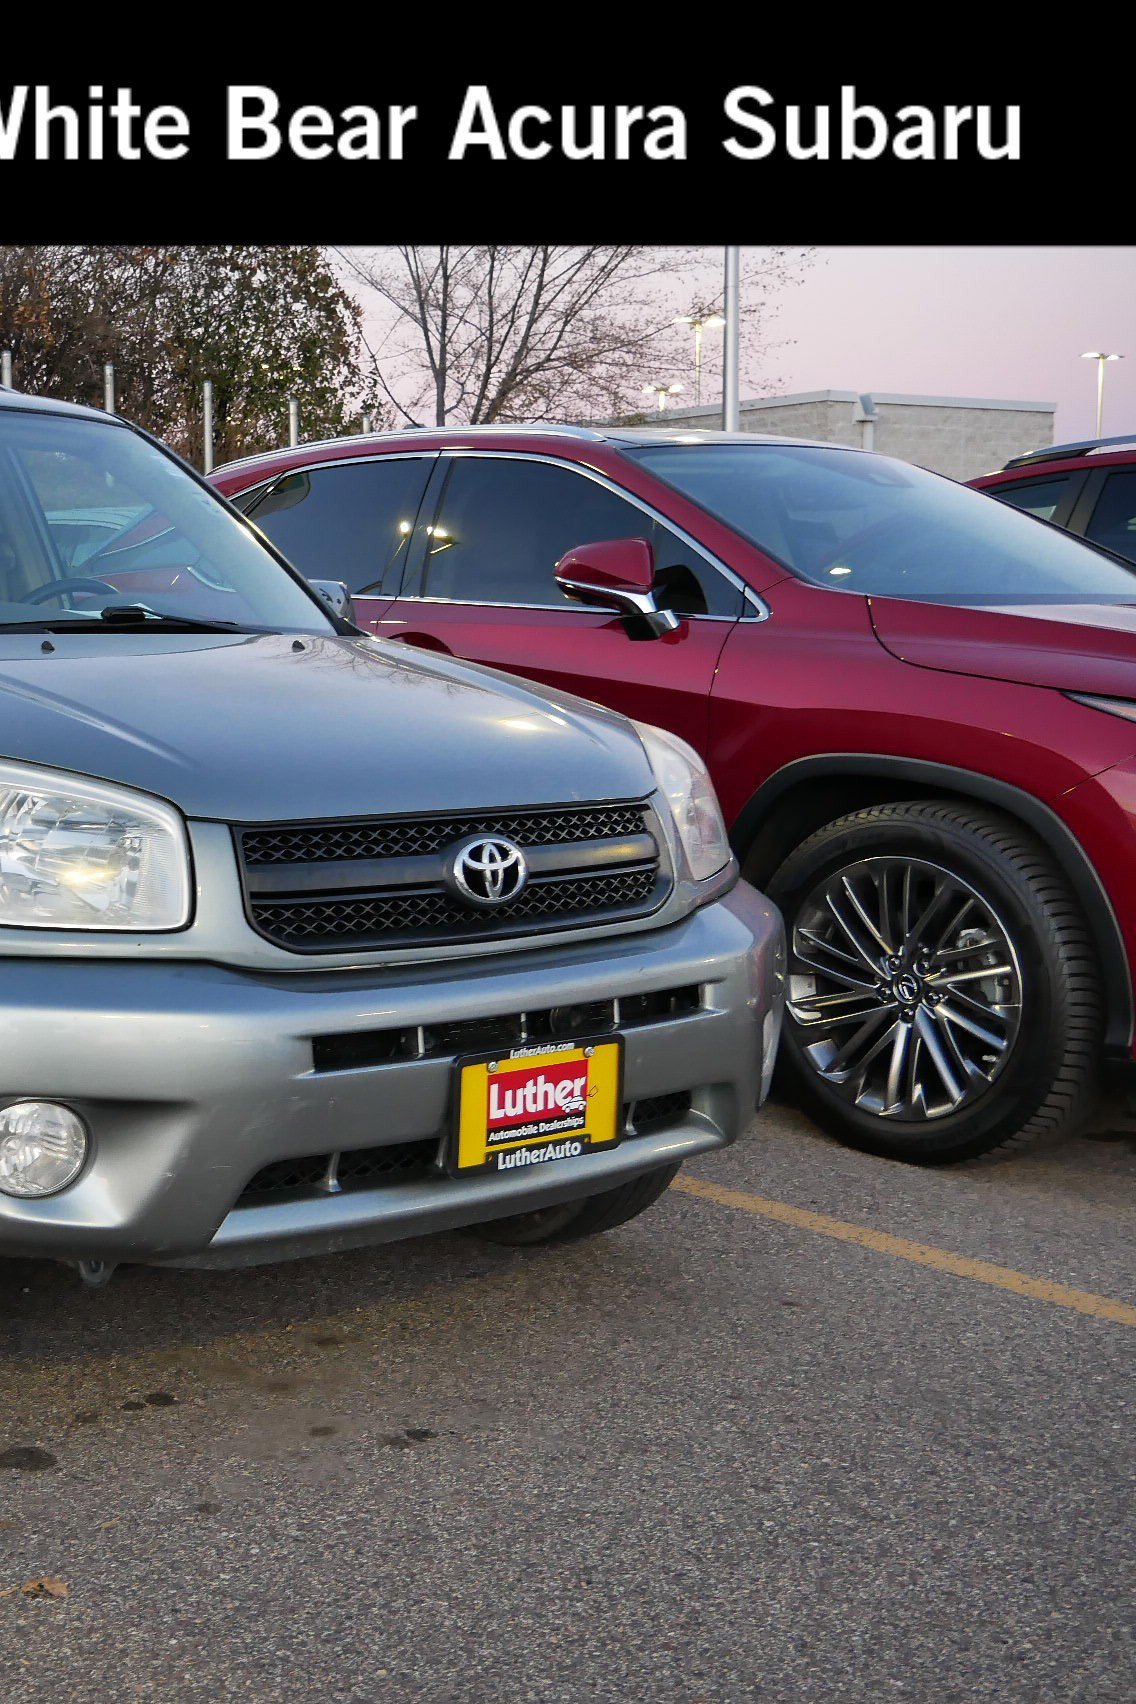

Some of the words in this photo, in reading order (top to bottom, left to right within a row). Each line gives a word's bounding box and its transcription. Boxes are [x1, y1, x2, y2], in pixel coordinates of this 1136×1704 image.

[509, 1042, 575, 1059] LutherAuto.com
[489, 1074, 587, 1120] Luther
[488, 1124, 539, 1142] Automobile
[539, 1116, 584, 1133] Dealerships
[497, 1140, 582, 1170] LutherAuto
